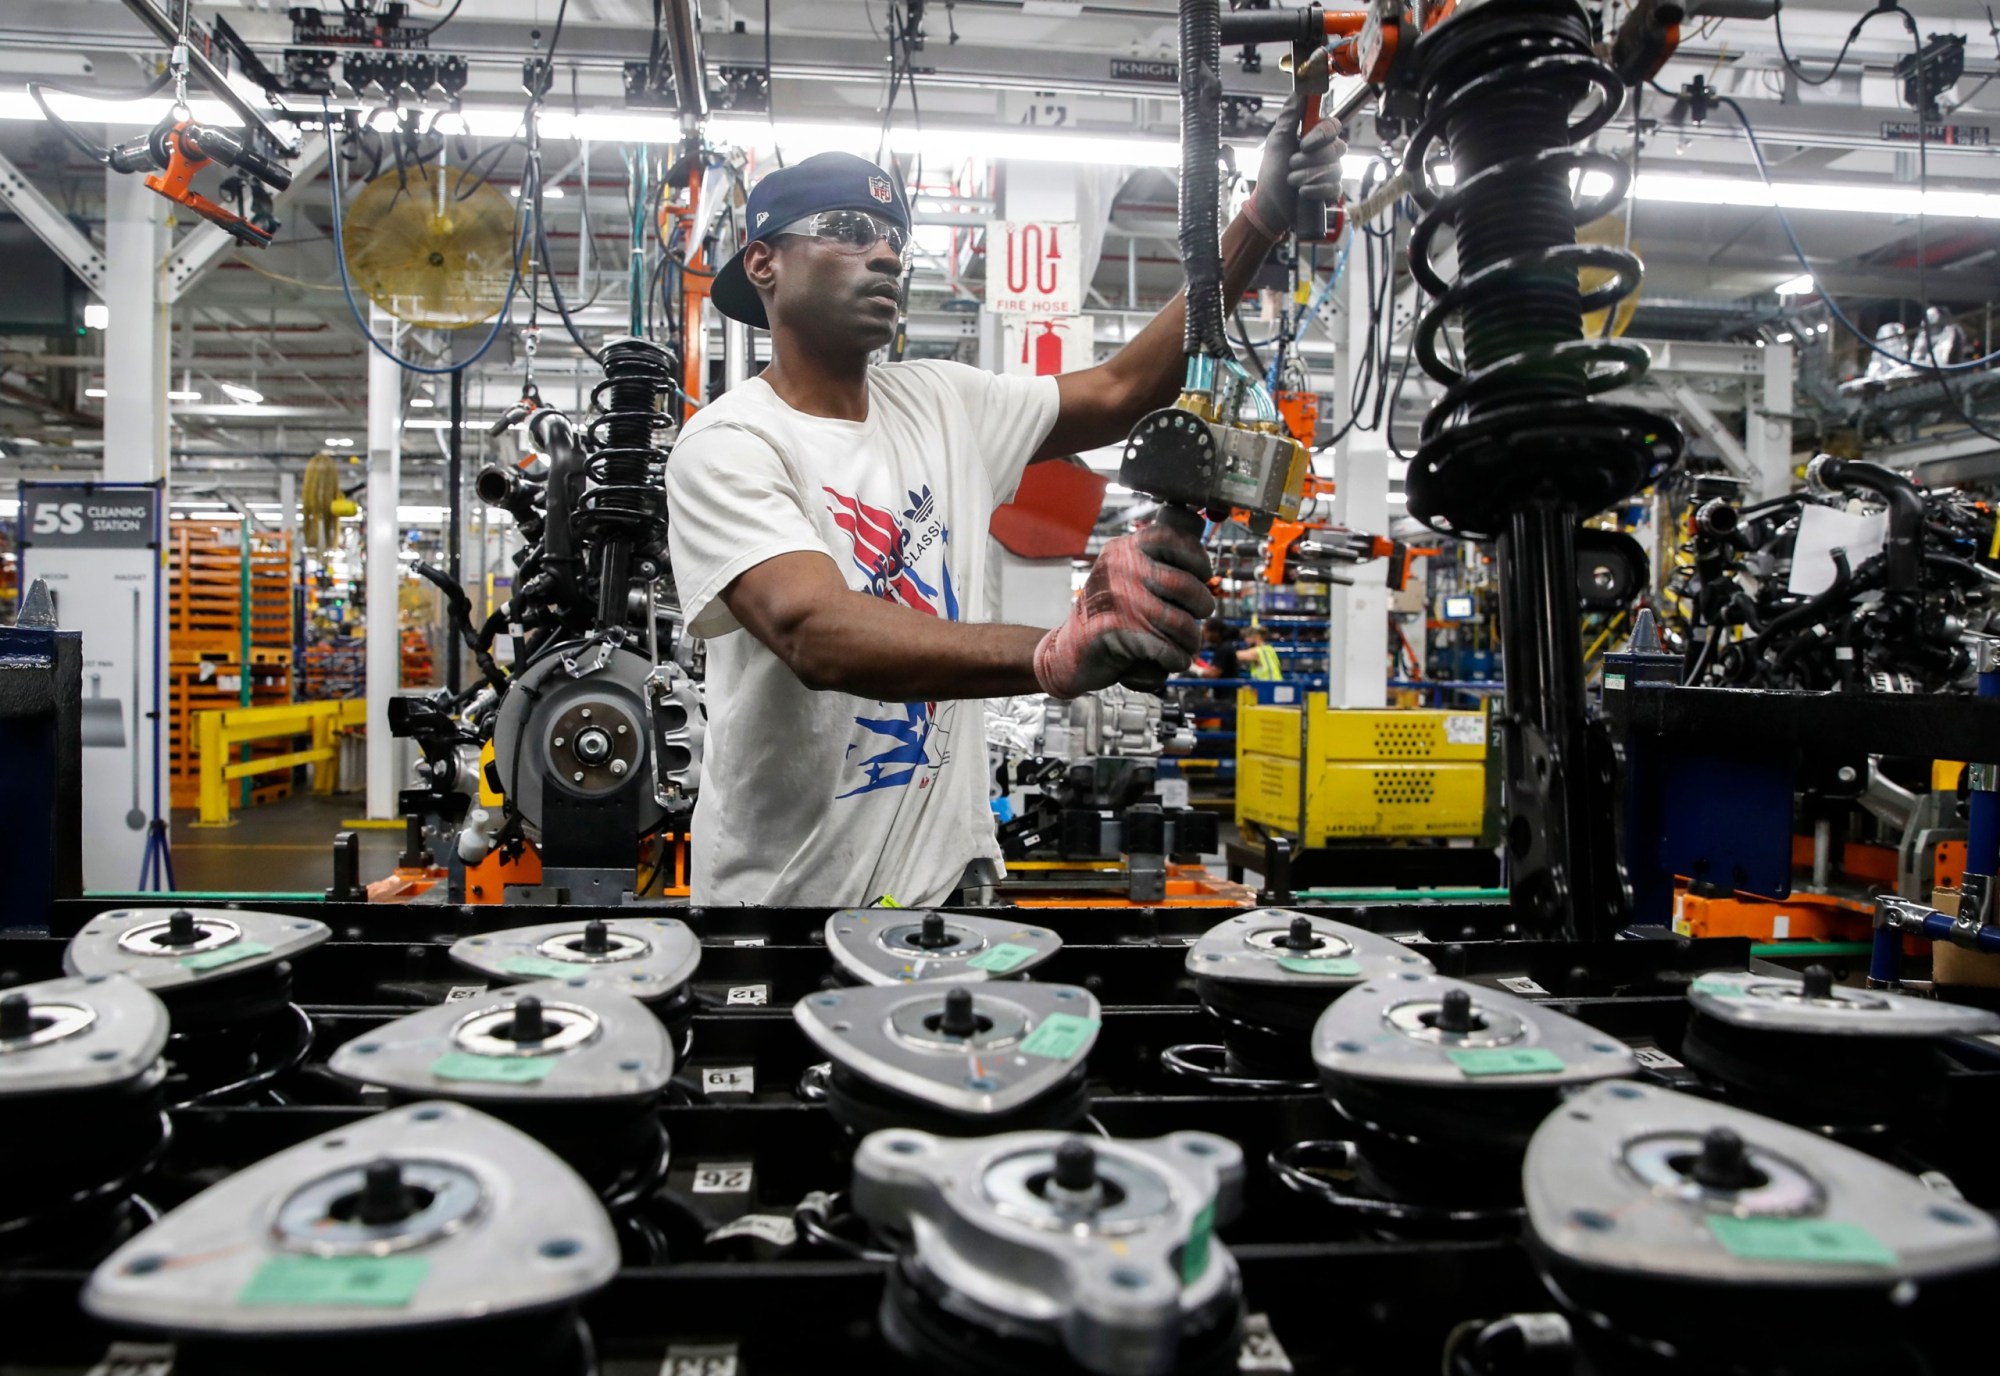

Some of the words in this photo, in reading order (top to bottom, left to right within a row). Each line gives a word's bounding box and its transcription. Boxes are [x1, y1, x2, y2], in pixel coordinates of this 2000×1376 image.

[873, 186, 892, 202] NFL
[996, 299, 1027, 312] FIRE
[1032, 300, 1070, 313] HOSE
[32, 502, 85, 535] 5S
[86, 506, 147, 519] CLEANING
[92, 520, 140, 531] STATION
[732, 988, 758, 1000] 12
[707, 1072, 742, 1086] 19
[701, 1169, 745, 1188] 26
